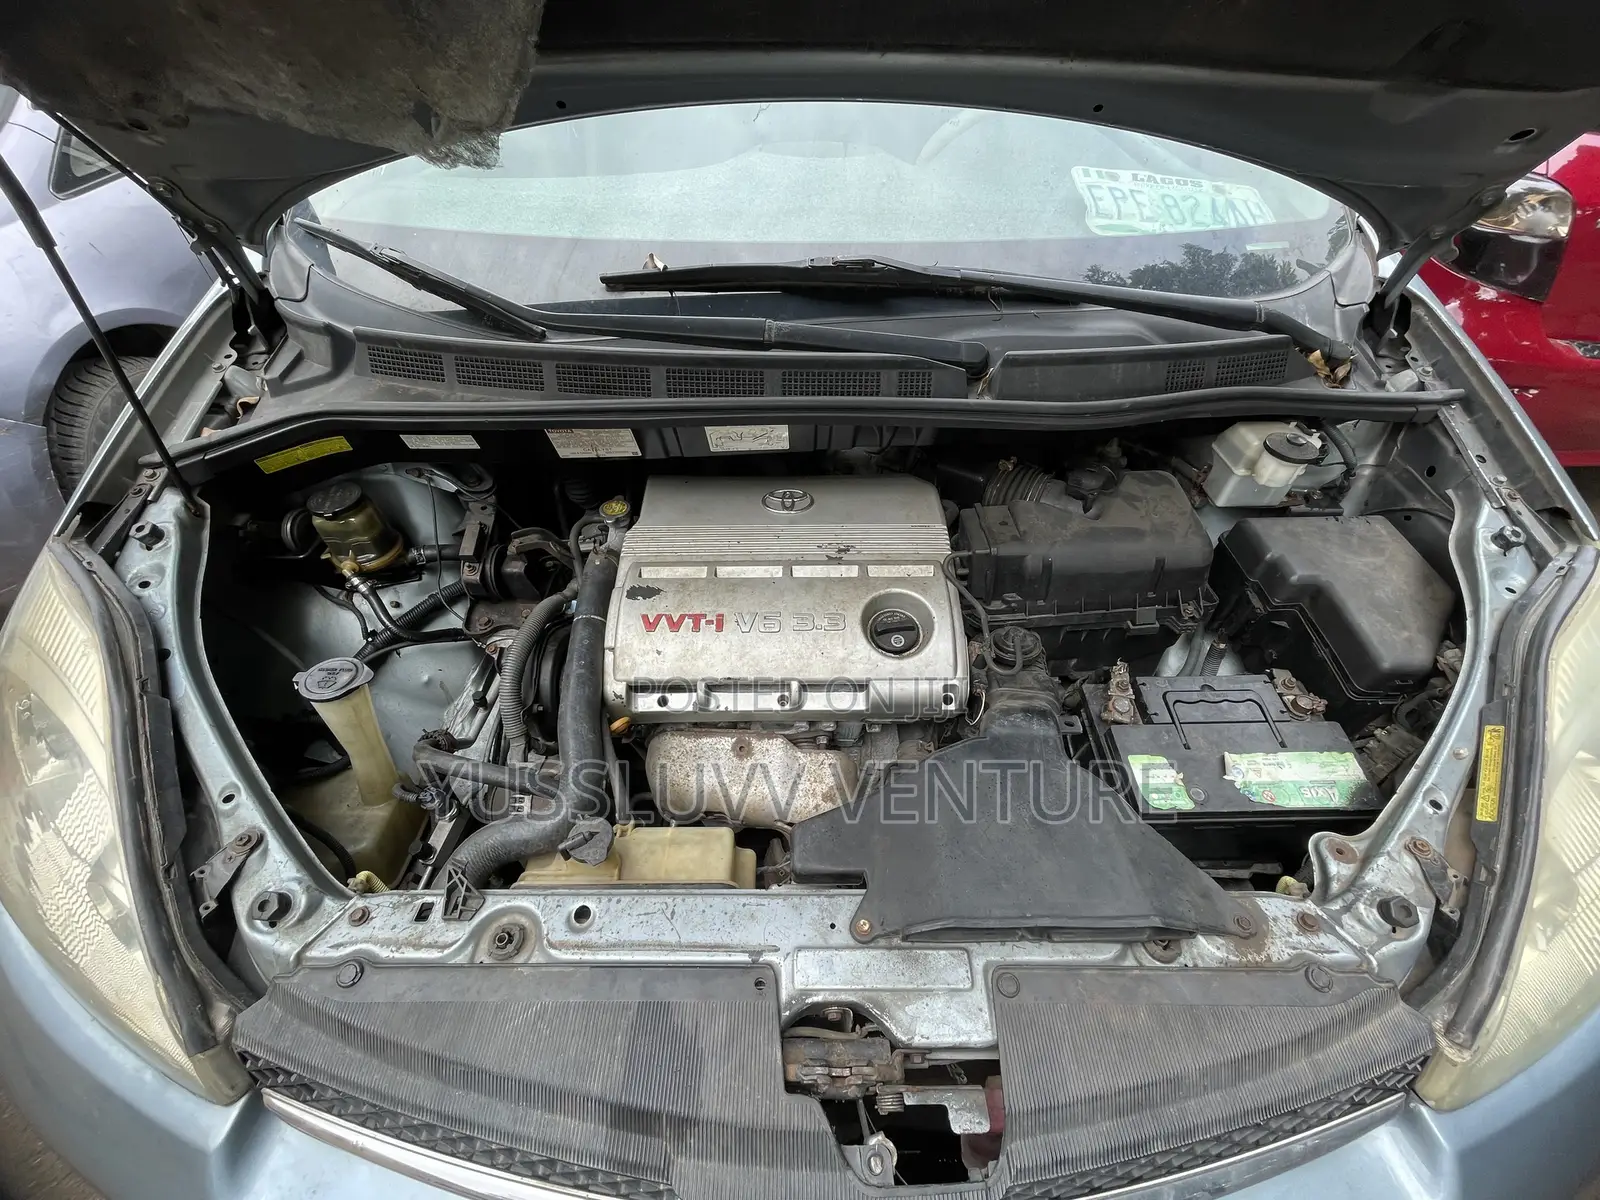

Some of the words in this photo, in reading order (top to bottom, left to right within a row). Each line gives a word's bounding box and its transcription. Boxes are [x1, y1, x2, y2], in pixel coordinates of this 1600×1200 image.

[1131, 172, 1204, 188] LAGOS
[640, 612, 724, 633] VVT-i
[734, 611, 781, 634] V6
[792, 612, 847, 632] 3.3
